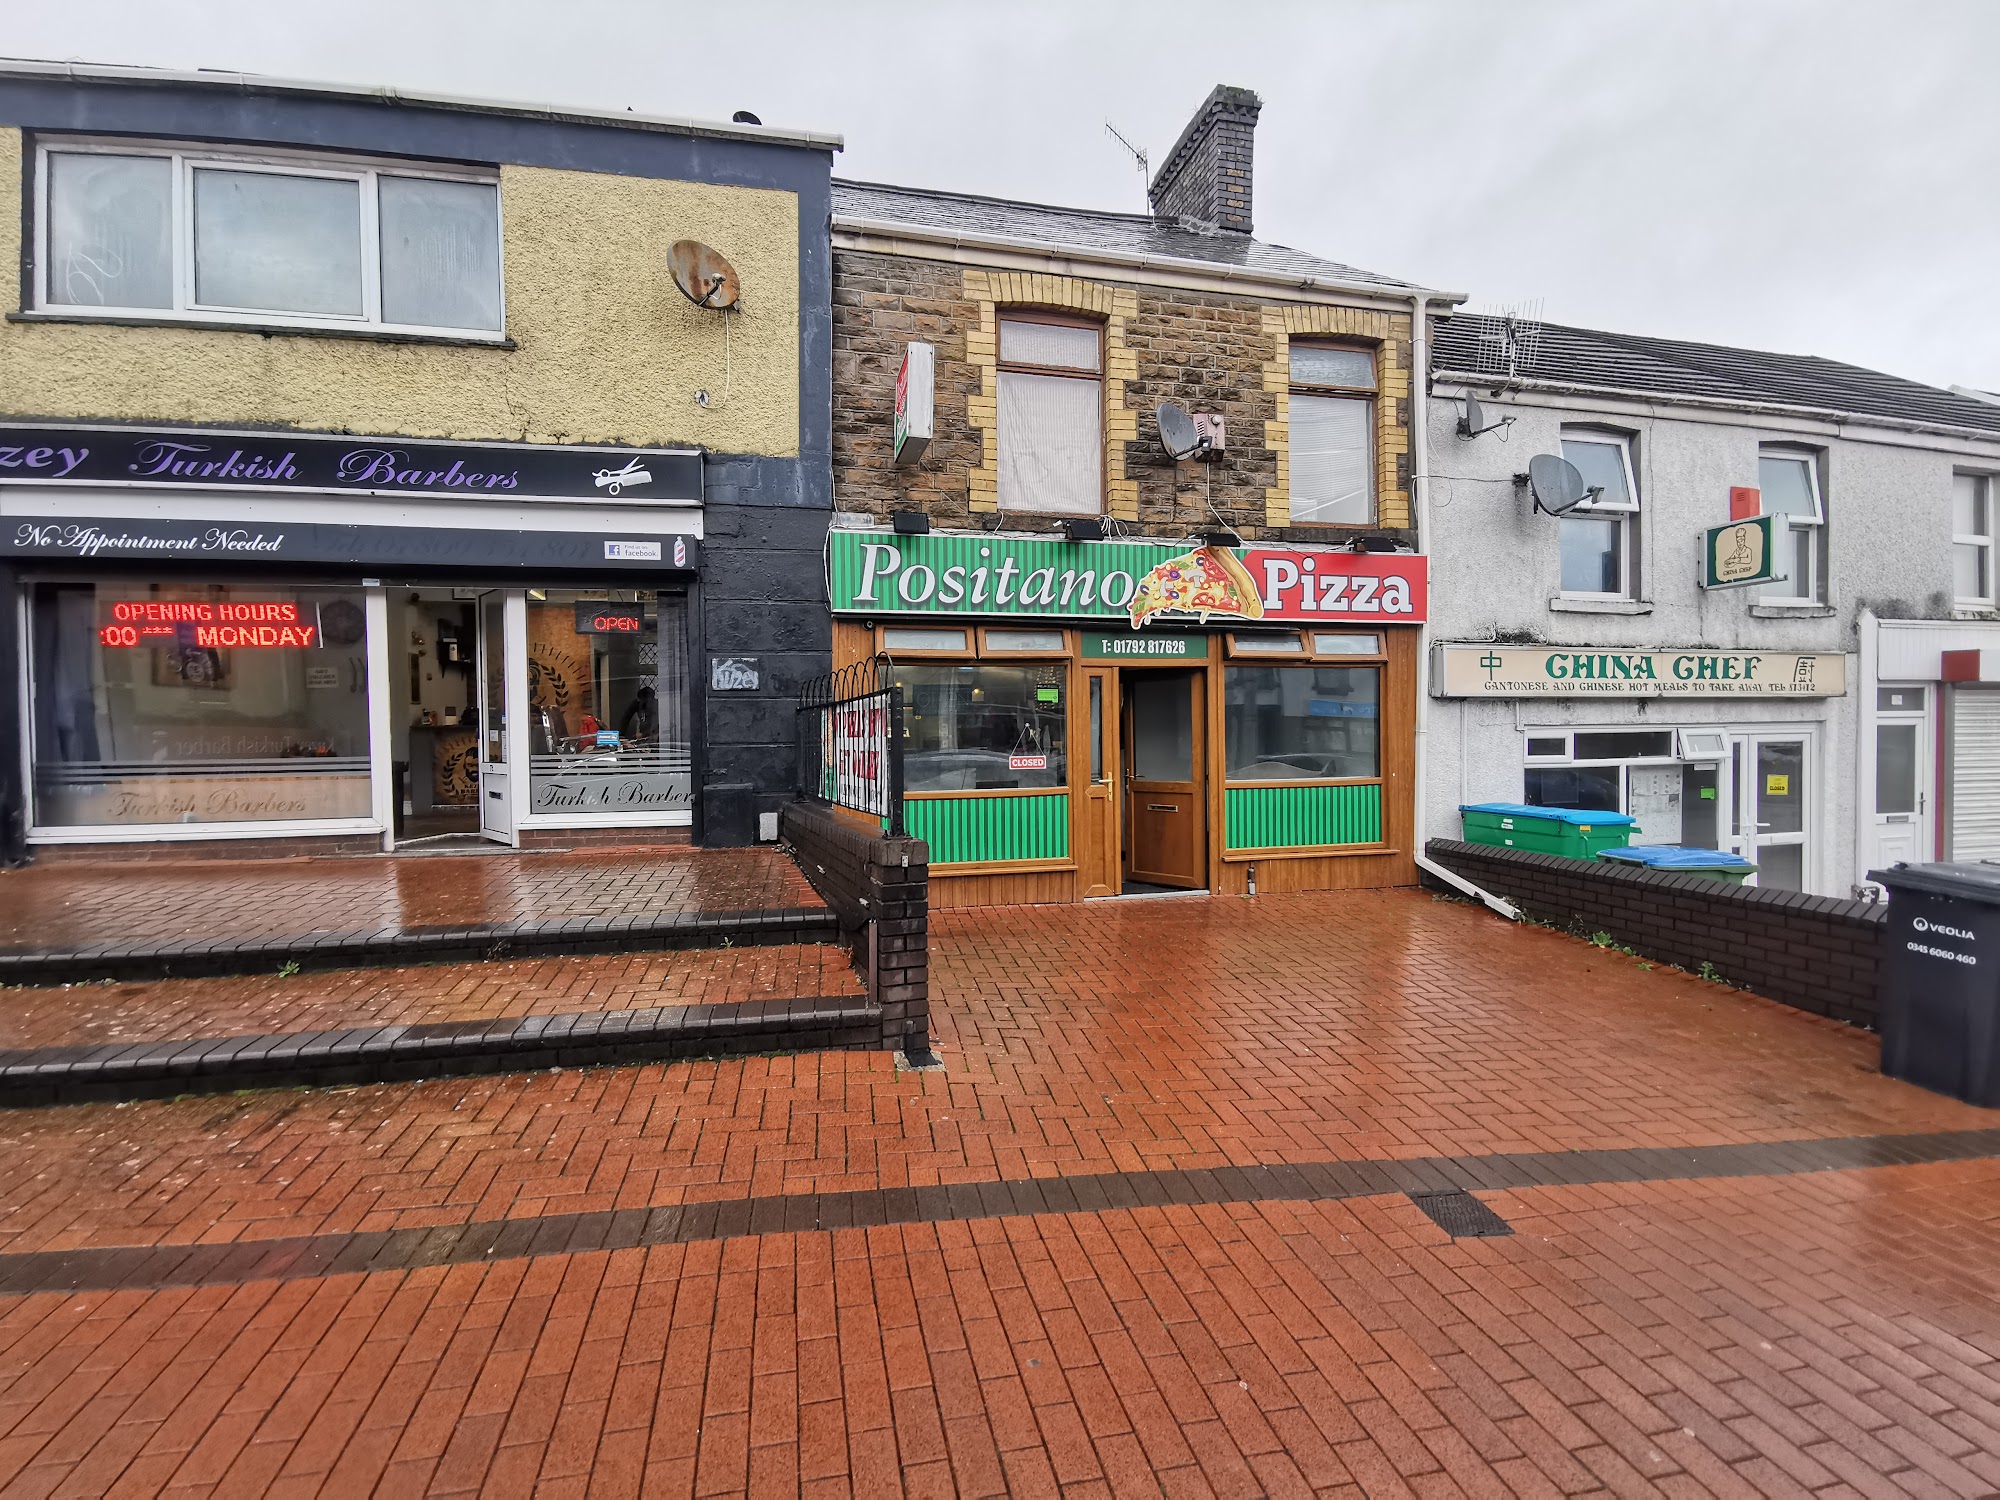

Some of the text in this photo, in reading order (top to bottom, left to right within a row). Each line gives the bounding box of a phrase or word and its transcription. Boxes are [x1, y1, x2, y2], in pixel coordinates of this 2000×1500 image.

[128, 439, 303, 480] Turkish
[336, 449, 519, 490] Barbers
[14, 523, 62, 547] No
[57, 524, 198, 556] Appointment
[201, 528, 285, 552] Needed
[852, 543, 1136, 607] Positano
[1262, 557, 1414, 614] Pizza
[113, 603, 296, 621] OPENING HOURS
[594, 616, 640, 631] OPEN
[197, 626, 313, 646] MONDAY
[1101, 639, 1186, 654] T: 01792 817626
[1480, 650, 1502, 681] 中
[1484, 681, 1549, 691] CANTONESE
[1553, 681, 1575, 691] AND
[1579, 682, 1625, 691] CHINESE
[1629, 682, 1649, 692] HOT
[1653, 682, 1689, 692] MEALS
[1692, 683, 1705, 692] TO
[1709, 683, 1735, 692] TAKE
[1011, 758, 1044, 768] CLOSED
[1929, 923, 1975, 941] VEOLIA
[1906, 941, 1977, 965] 0345 6060 460
